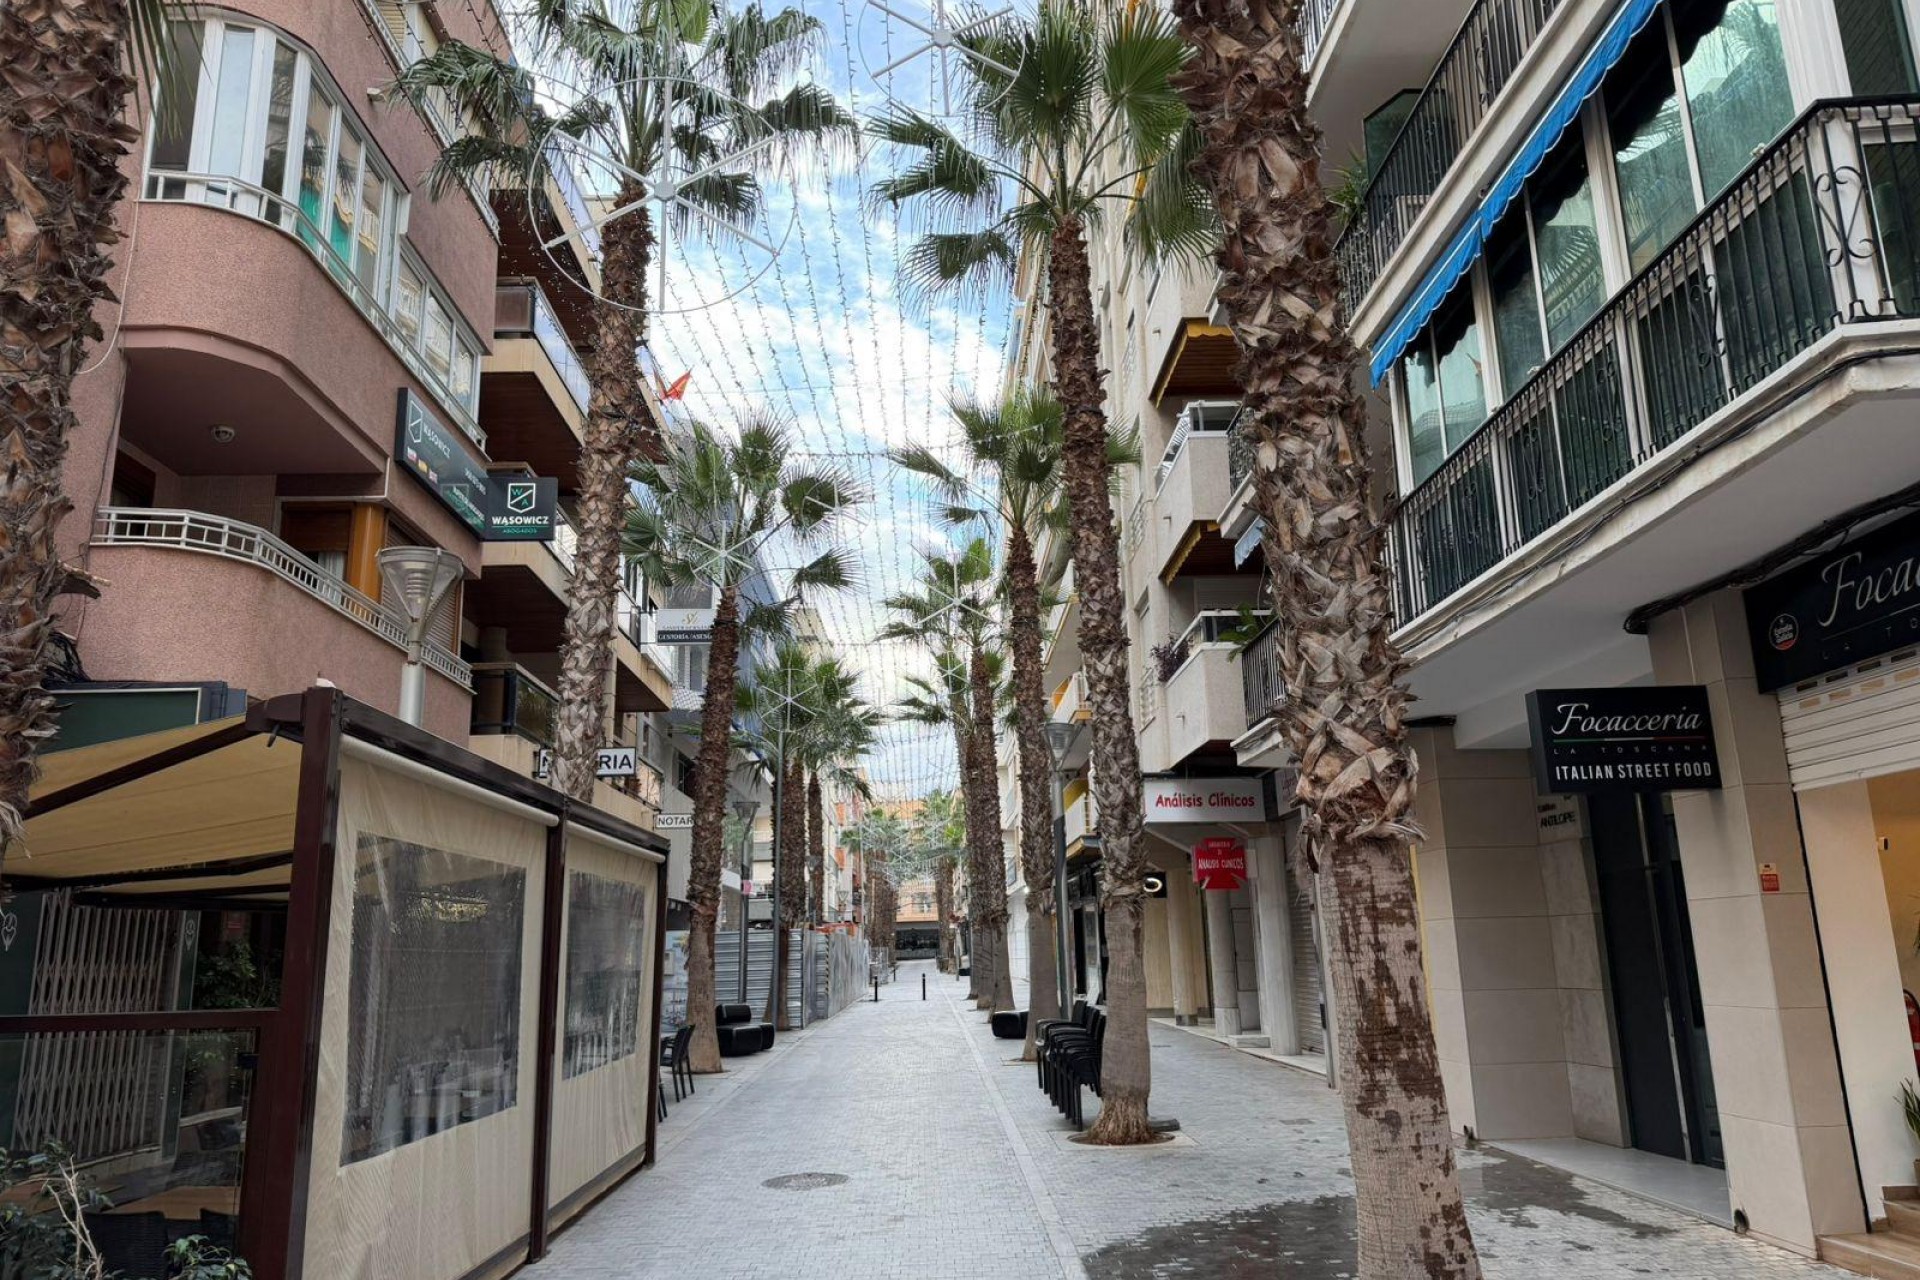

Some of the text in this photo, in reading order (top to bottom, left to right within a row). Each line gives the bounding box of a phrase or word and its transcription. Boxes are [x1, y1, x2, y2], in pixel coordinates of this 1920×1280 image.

[511, 487, 523, 496] W
[521, 499, 529, 507] A
[1551, 702, 1703, 736] Focacceria
[1553, 745, 1707, 756] LA TOSCANA
[1555, 760, 1712, 780] ITALIAN STREET FOOD
[1156, 791, 1255, 808] Análisis Clínicos
